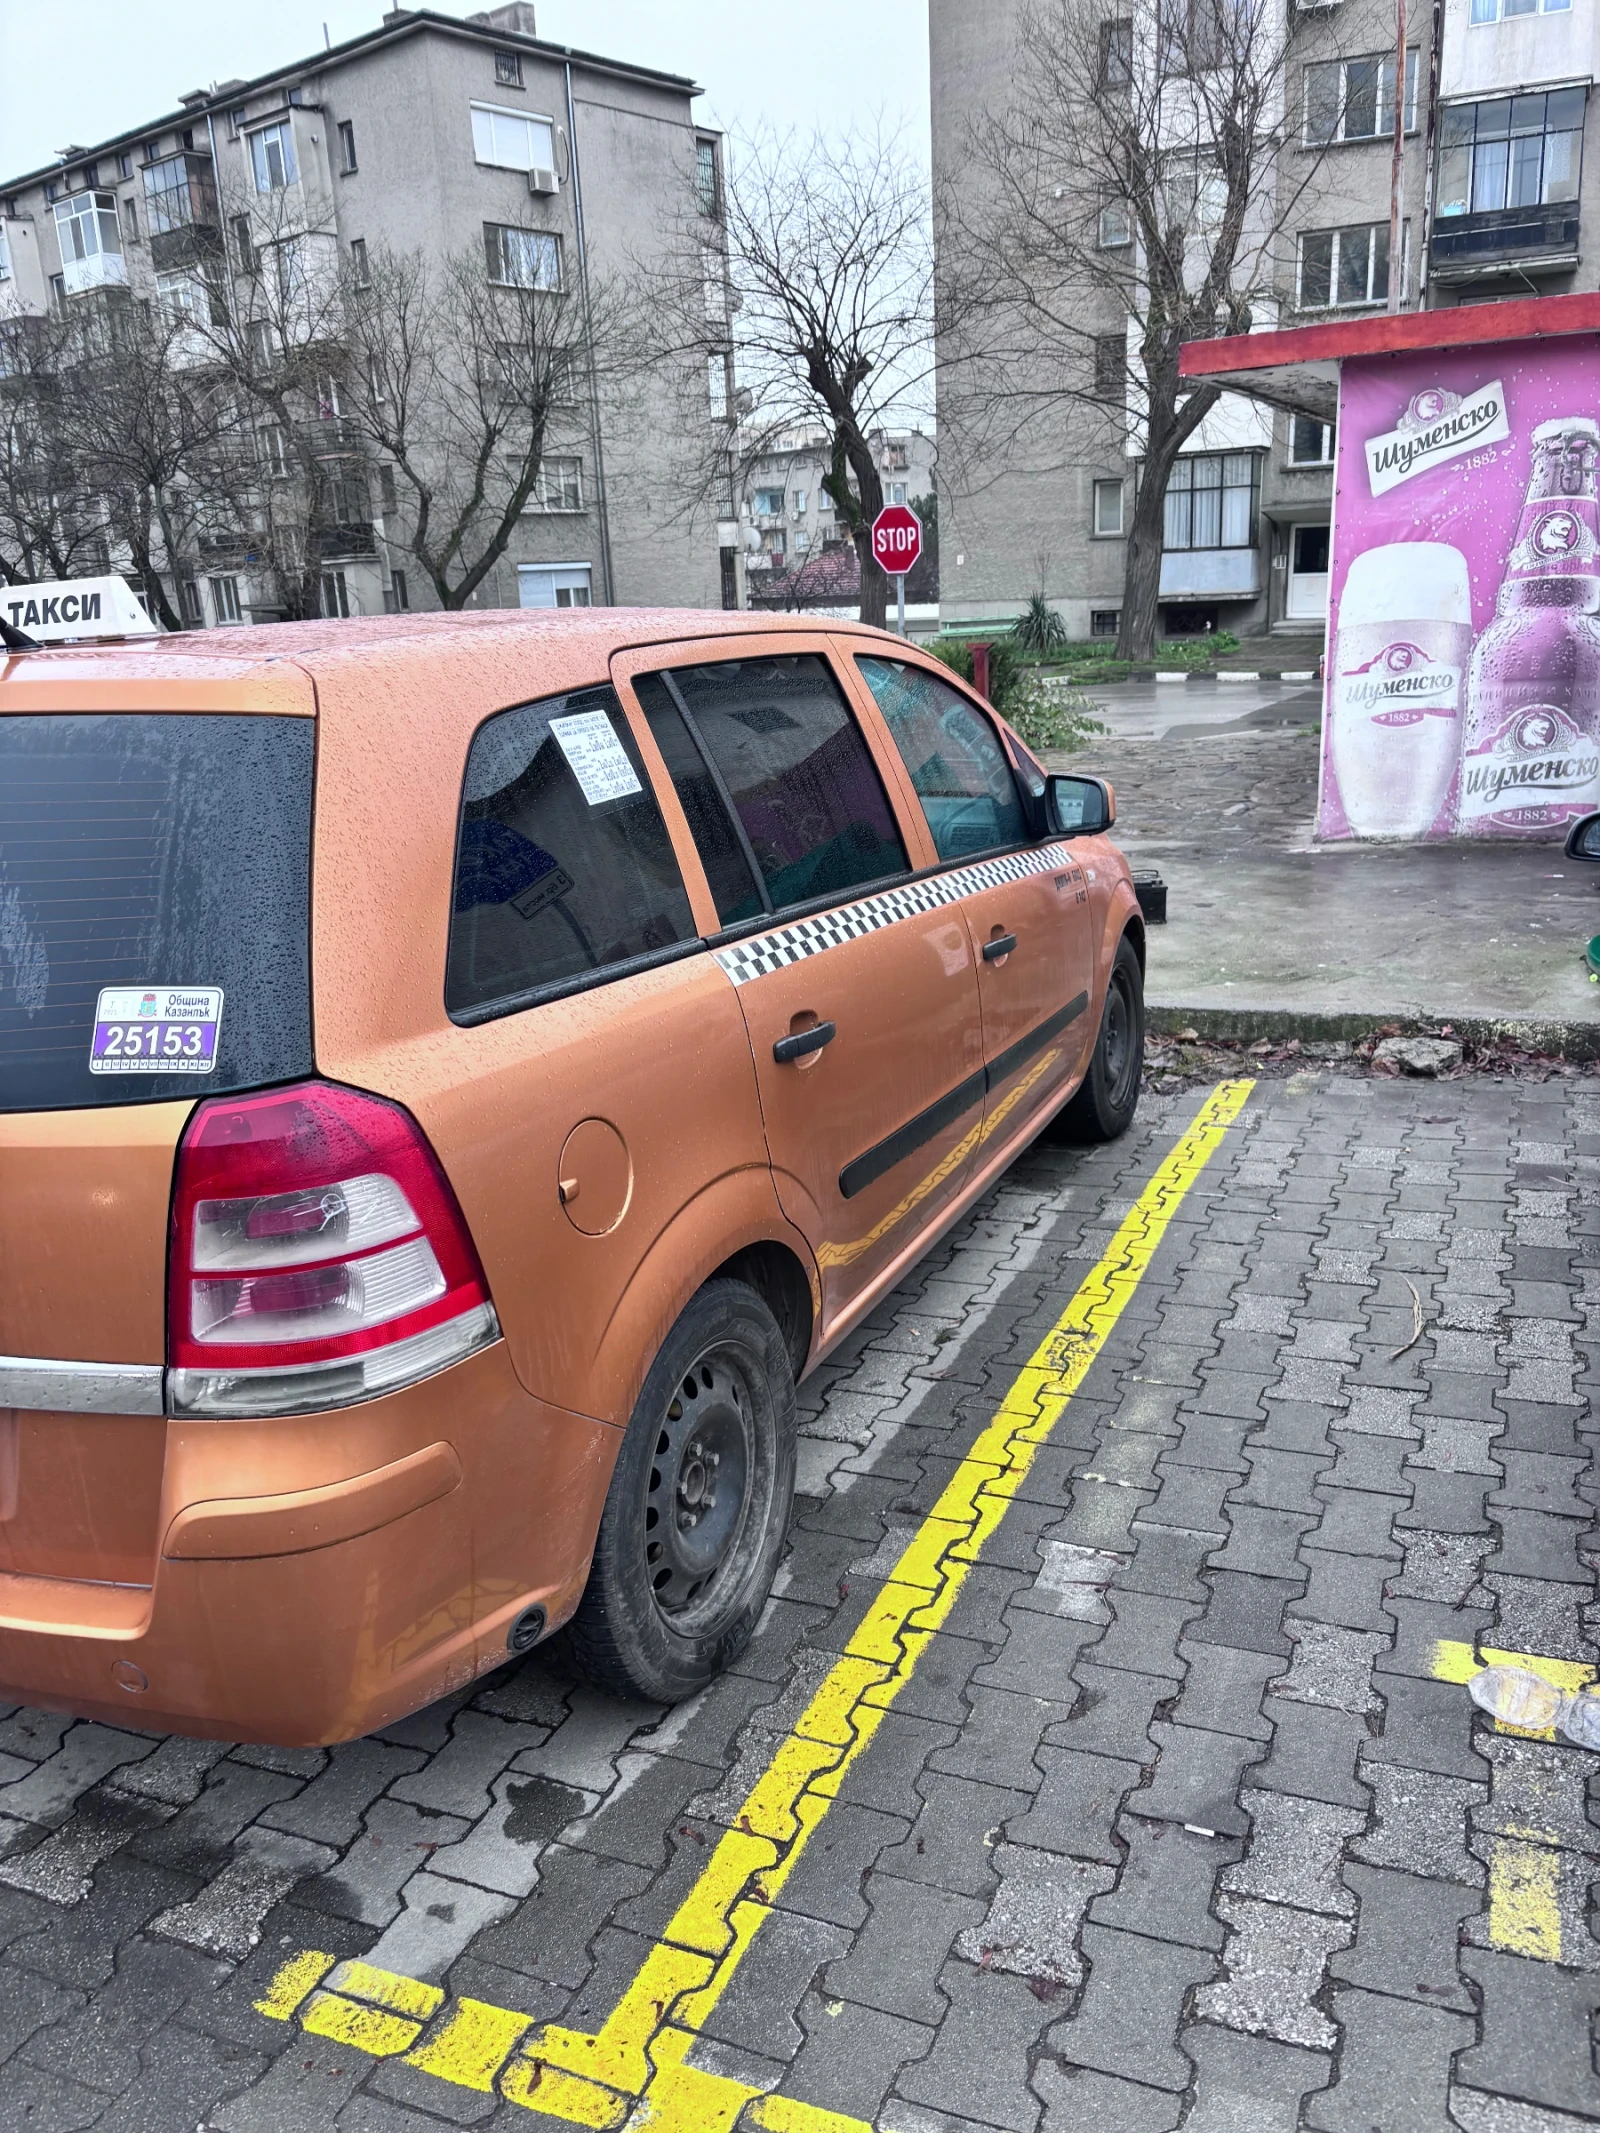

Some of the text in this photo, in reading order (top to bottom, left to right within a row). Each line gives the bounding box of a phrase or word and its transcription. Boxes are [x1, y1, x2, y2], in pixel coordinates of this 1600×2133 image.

[1373, 400, 1501, 474] Шуменско
[1464, 451, 1498, 471] 1882
[877, 526, 917, 552] STOP
[8, 593, 101, 628] ТАКСИ
[1346, 674, 1454, 709] Шуменско
[1388, 712, 1410, 723] 1882
[1466, 755, 1600, 803] Шуменско
[1516, 809, 1548, 821] 1882
[165, 1005, 210, 1018] Казанлък
[168, 994, 210, 1006] Община
[103, 1025, 203, 1056] 25153
